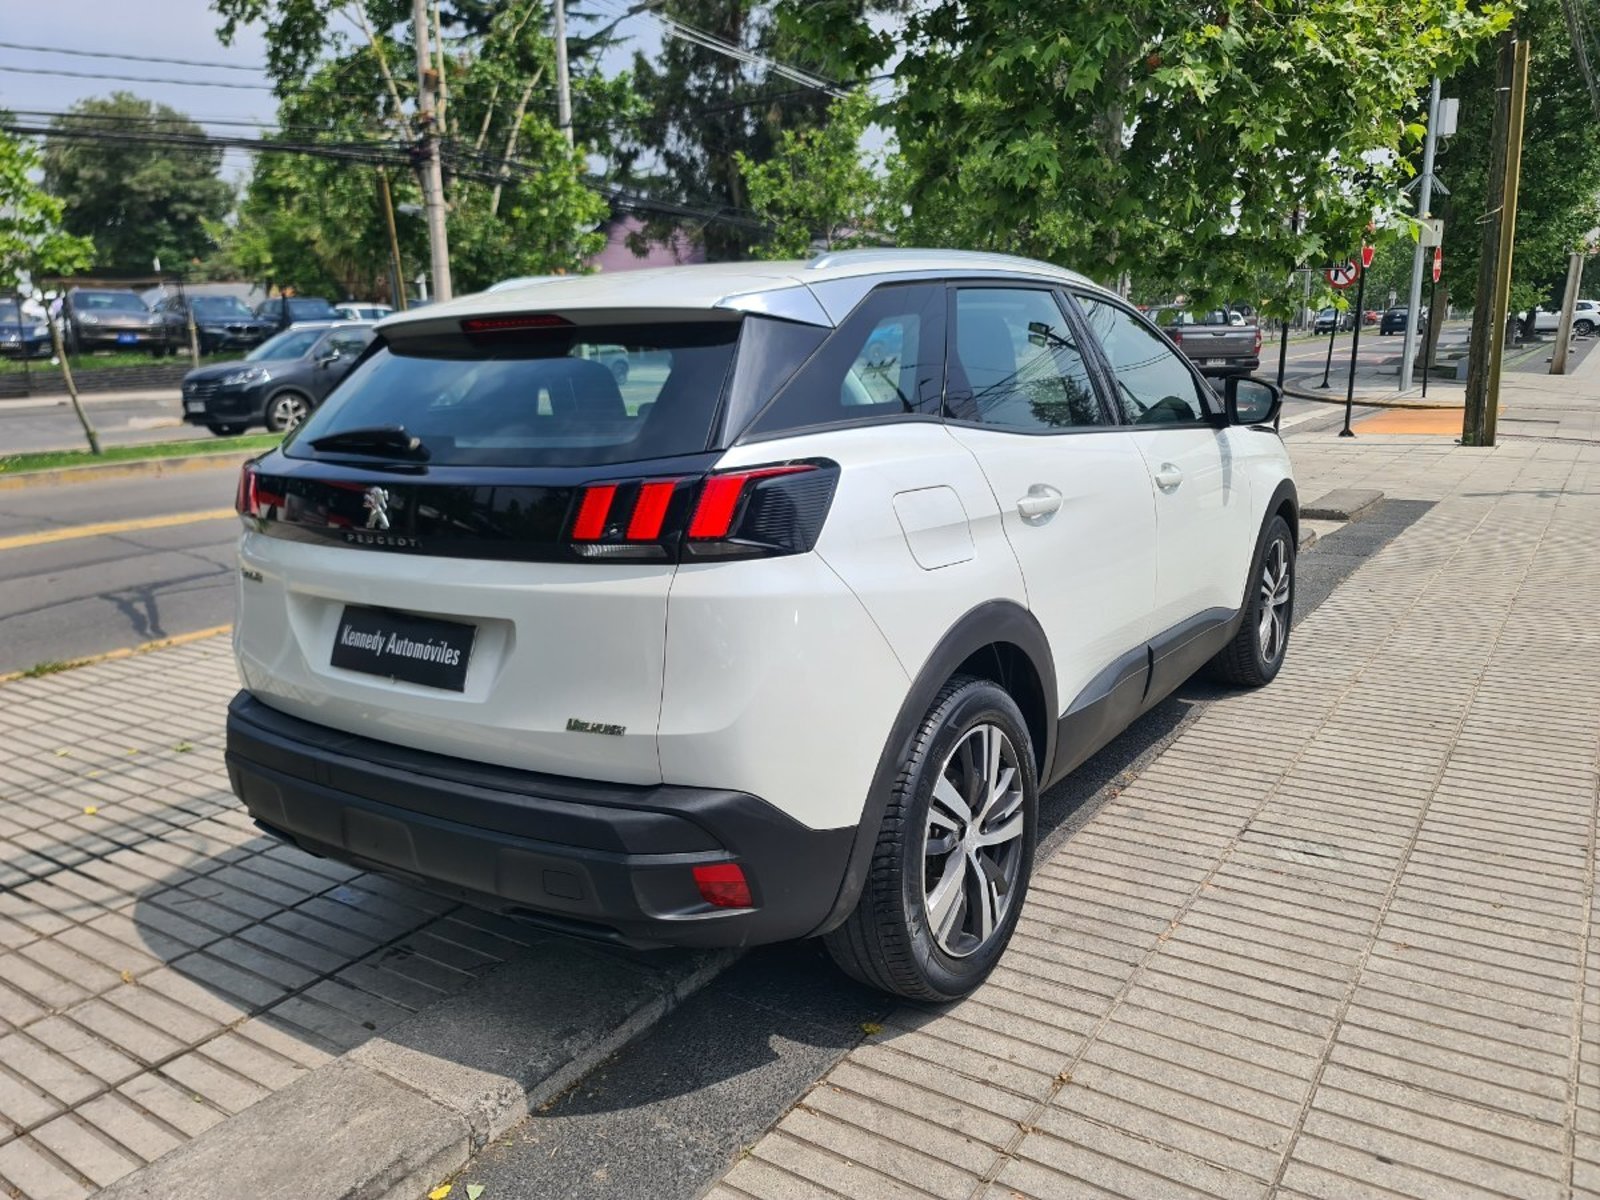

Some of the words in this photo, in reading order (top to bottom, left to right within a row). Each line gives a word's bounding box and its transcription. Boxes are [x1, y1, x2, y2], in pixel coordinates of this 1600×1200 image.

[347, 533, 417, 547] PEUGEOT
[341, 624, 386, 657] Kennedy
[386, 632, 461, 666] Automóviles
